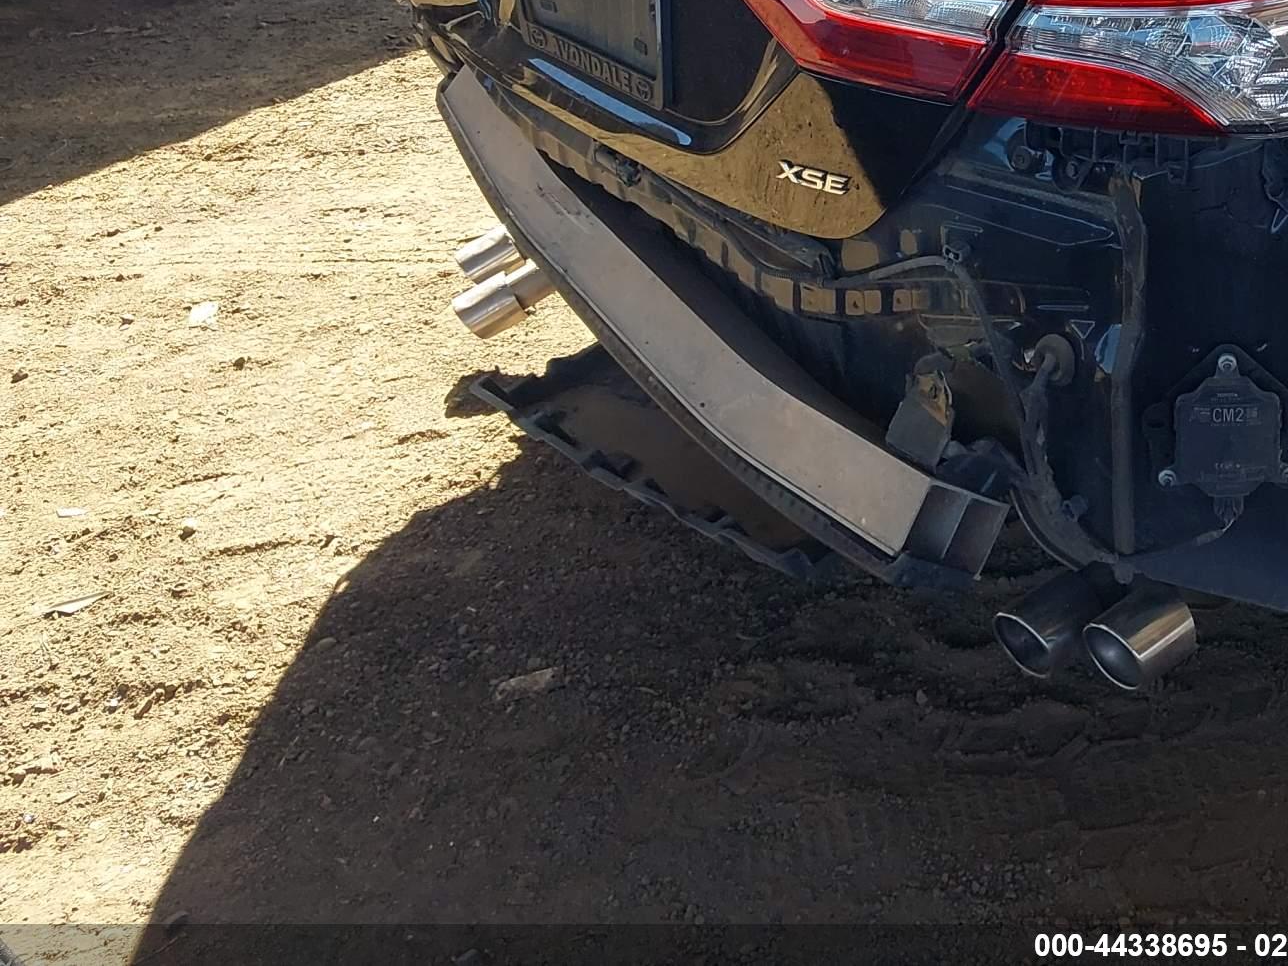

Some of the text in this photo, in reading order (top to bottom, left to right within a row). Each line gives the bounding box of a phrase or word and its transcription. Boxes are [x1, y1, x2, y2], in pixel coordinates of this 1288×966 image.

[551, 36, 631, 92] AVONDALE
[776, 160, 851, 195] XSE
[1212, 407, 1245, 423] CM2
